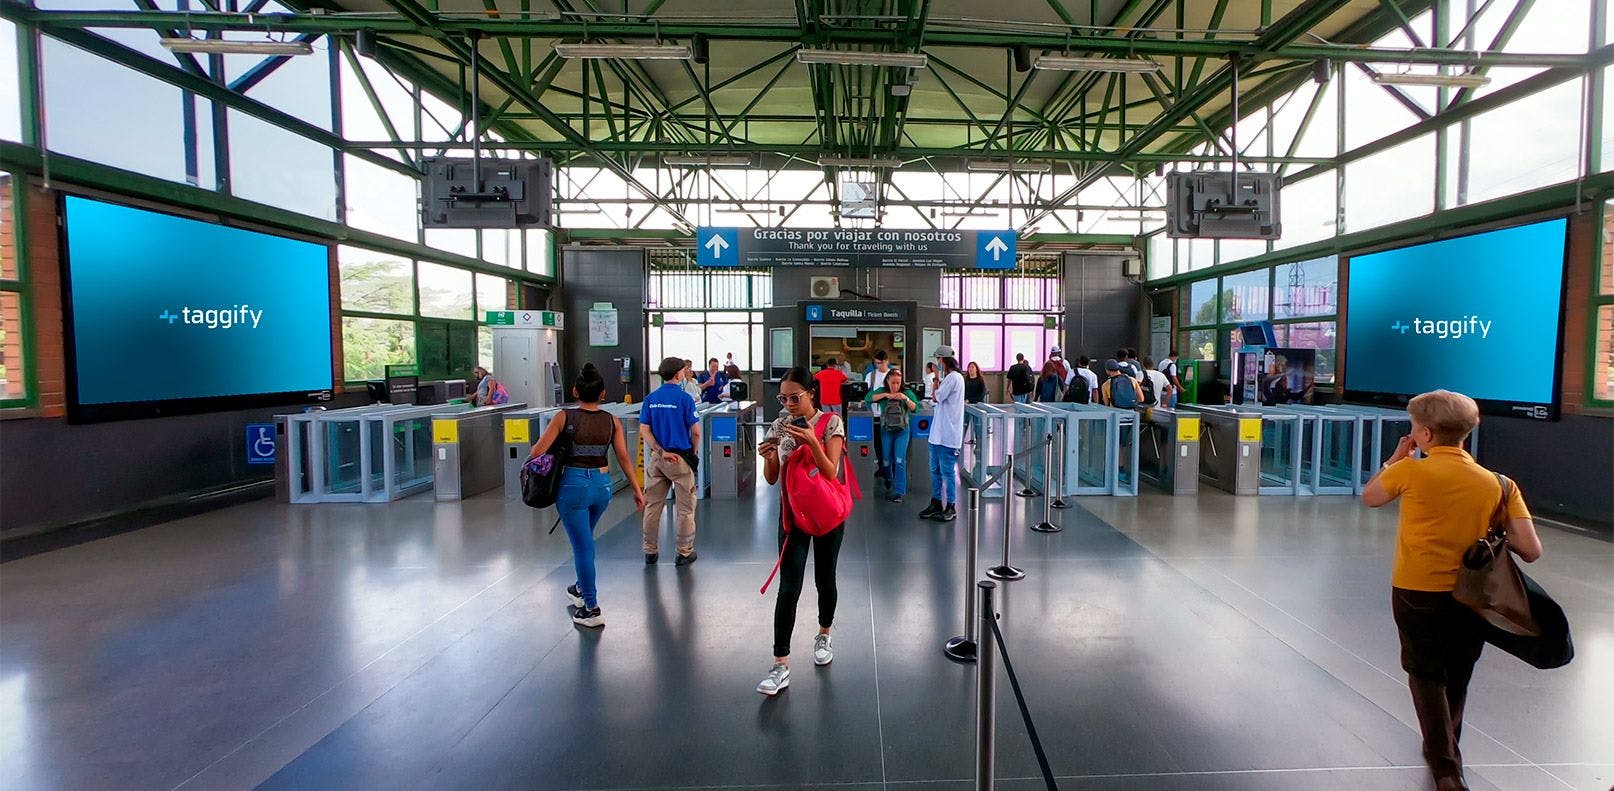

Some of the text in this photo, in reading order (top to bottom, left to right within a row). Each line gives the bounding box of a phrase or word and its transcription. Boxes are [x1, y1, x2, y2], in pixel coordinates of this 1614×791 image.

[753, 228, 962, 242] Gracias por viajar con nosotros
[788, 241, 814, 250] Thank
[817, 242, 833, 251] you
[836, 242, 850, 250] for
[853, 242, 893, 252] traveling
[895, 243, 915, 251] with
[181, 304, 263, 329] taggify
[830, 309, 863, 319] Taquilla
[1413, 315, 1492, 339] taggify
